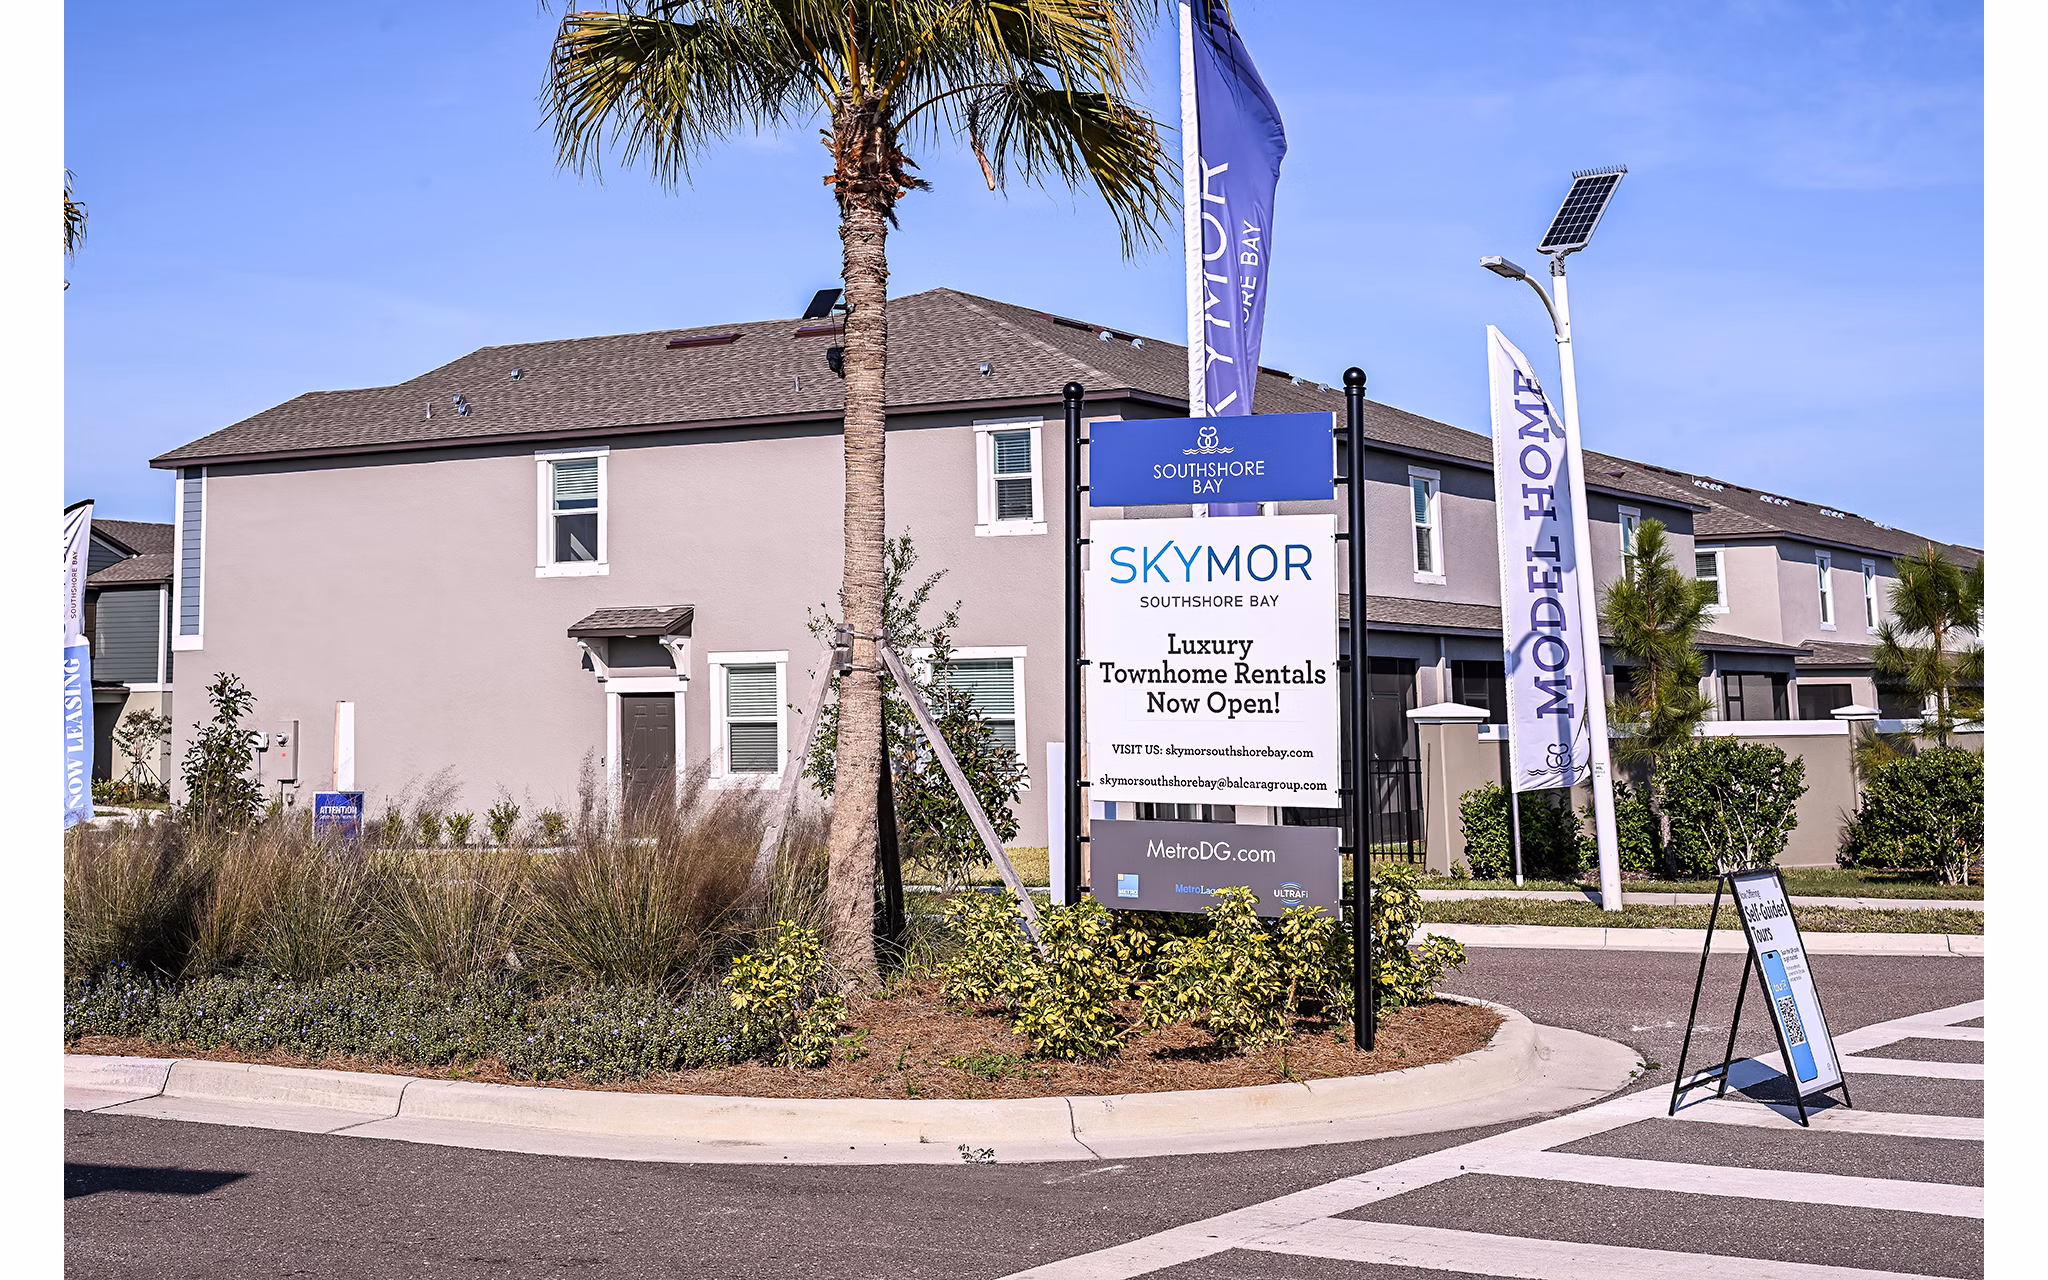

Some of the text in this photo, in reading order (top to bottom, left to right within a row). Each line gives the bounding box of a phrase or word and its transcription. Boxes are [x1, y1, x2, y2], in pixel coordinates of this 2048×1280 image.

[1240, 220, 1261, 266] BAY
[1153, 460, 1265, 480] SOUTHSHORE
[1193, 478, 1223, 494] BAY
[1513, 369, 1575, 719] MODEL HOME
[1110, 540, 1312, 584] SKYMOR
[70, 567, 78, 619] SOUTHSHORE
[1140, 595, 1279, 608] SOUTHSHORE BAY
[1167, 633, 1254, 660] Luxury
[1100, 660, 1327, 684] Townhome Rentals
[1147, 692, 1280, 719] Now Open!
[64, 658, 84, 810] NOW LEASING
[1112, 744, 1314, 760] VISIT US: skymorsouthshorebay.com
[1099, 774, 1328, 793] skymorsouthshorebay@balcaragroup.com
[320, 806, 357, 814] ATTENTION
[1147, 839, 1276, 863] MetroDG.com
[1744, 899, 1788, 922] Self-Guided
[1751, 926, 1773, 943] Tours
